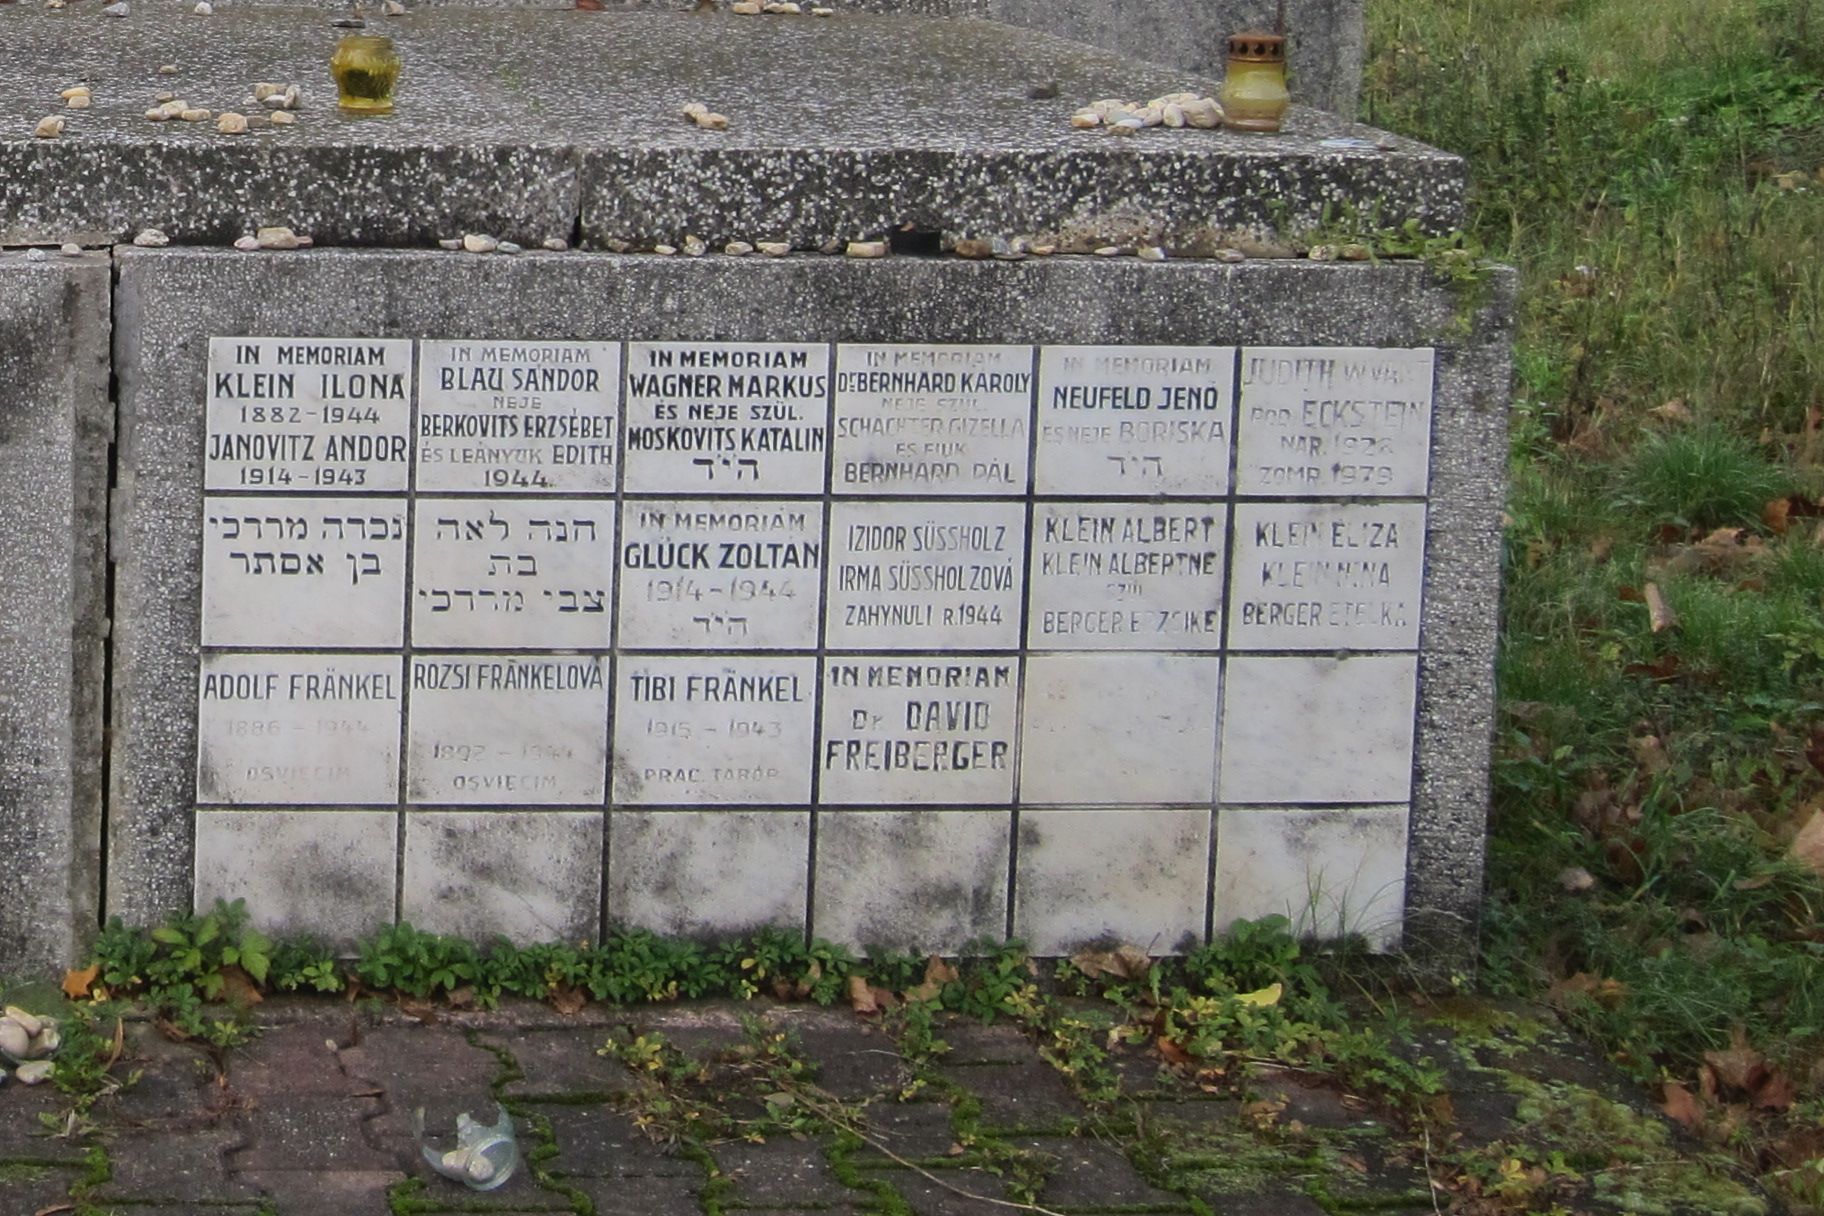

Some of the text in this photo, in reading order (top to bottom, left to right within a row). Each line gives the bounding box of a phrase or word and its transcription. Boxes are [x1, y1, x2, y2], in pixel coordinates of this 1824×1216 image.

[236, 346, 385, 365] IN MEMORIAM
[650, 352, 806, 367] IN MEMORIAM
[214, 374, 405, 400] KLEIN ILONA
[629, 374, 825, 398] WAGNER MARKUS
[1053, 387, 1149, 410] NEUFELD
[421, 414, 518, 437] BERKOVITS
[210, 435, 407, 462] JANOVITZ ANDOR
[628, 427, 823, 452] MOSKOVITS KATALIN
[437, 510, 595, 541] חנה לאה
[848, 526, 904, 551] IZIDOR
[489, 555, 536, 575] בת
[624, 538, 708, 569] GLÜCK
[230, 552, 381, 585] בן אסתר
[544, 590, 605, 612] צבי
[846, 605, 931, 626] ZAHYNULI
[204, 668, 396, 700] ADOLF FRÄNKEL
[631, 669, 803, 702] TIBI FRÄNKEL
[907, 702, 989, 730] DAVID
[826, 741, 1008, 770] FREIBERGER
